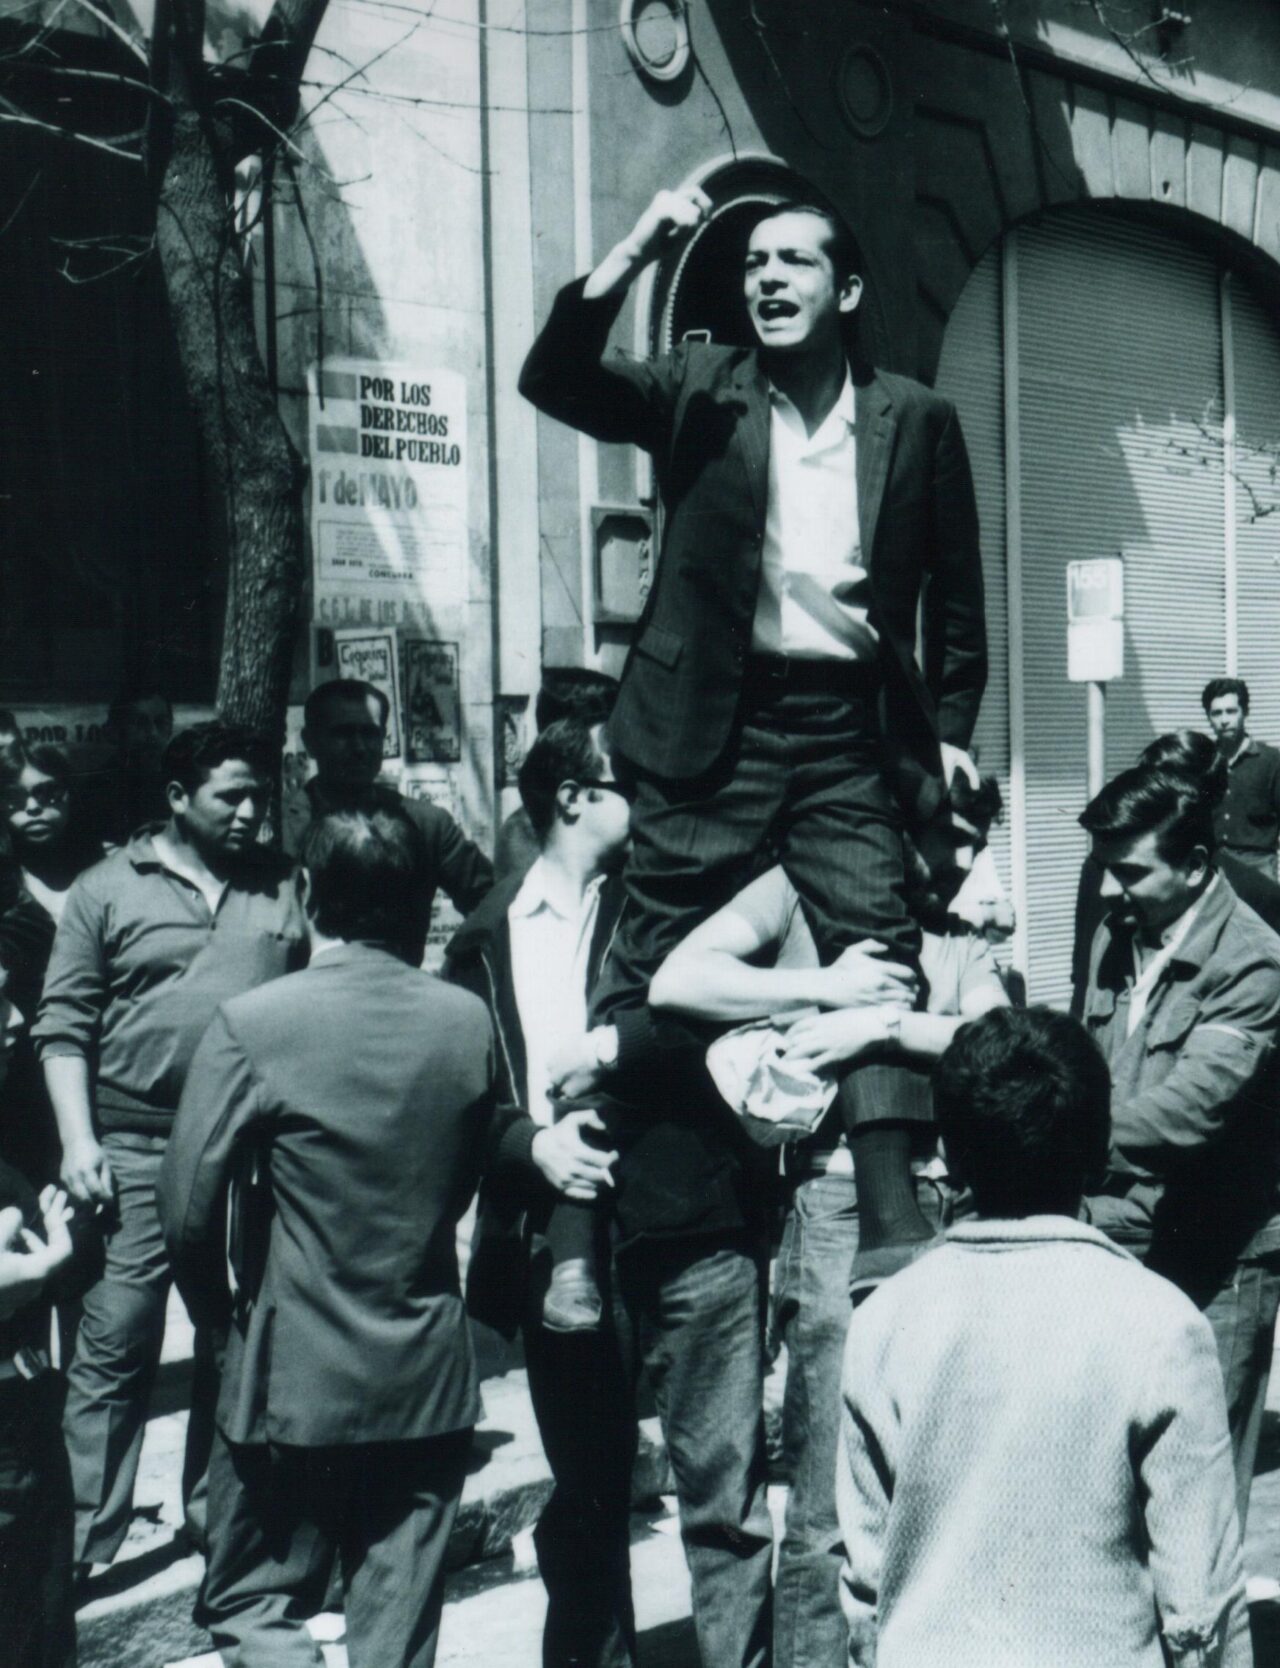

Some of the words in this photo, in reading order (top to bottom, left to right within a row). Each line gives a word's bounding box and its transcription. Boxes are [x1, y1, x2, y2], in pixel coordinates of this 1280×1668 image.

[360, 375, 395, 402] POR
[400, 381, 431, 407] LOS
[360, 404, 449, 437] DERECHOS
[361, 434, 394, 459] DEL
[395, 438, 462, 467] PUEBLO
[332, 470, 358, 506] de
[359, 471, 418, 510] MAYO
